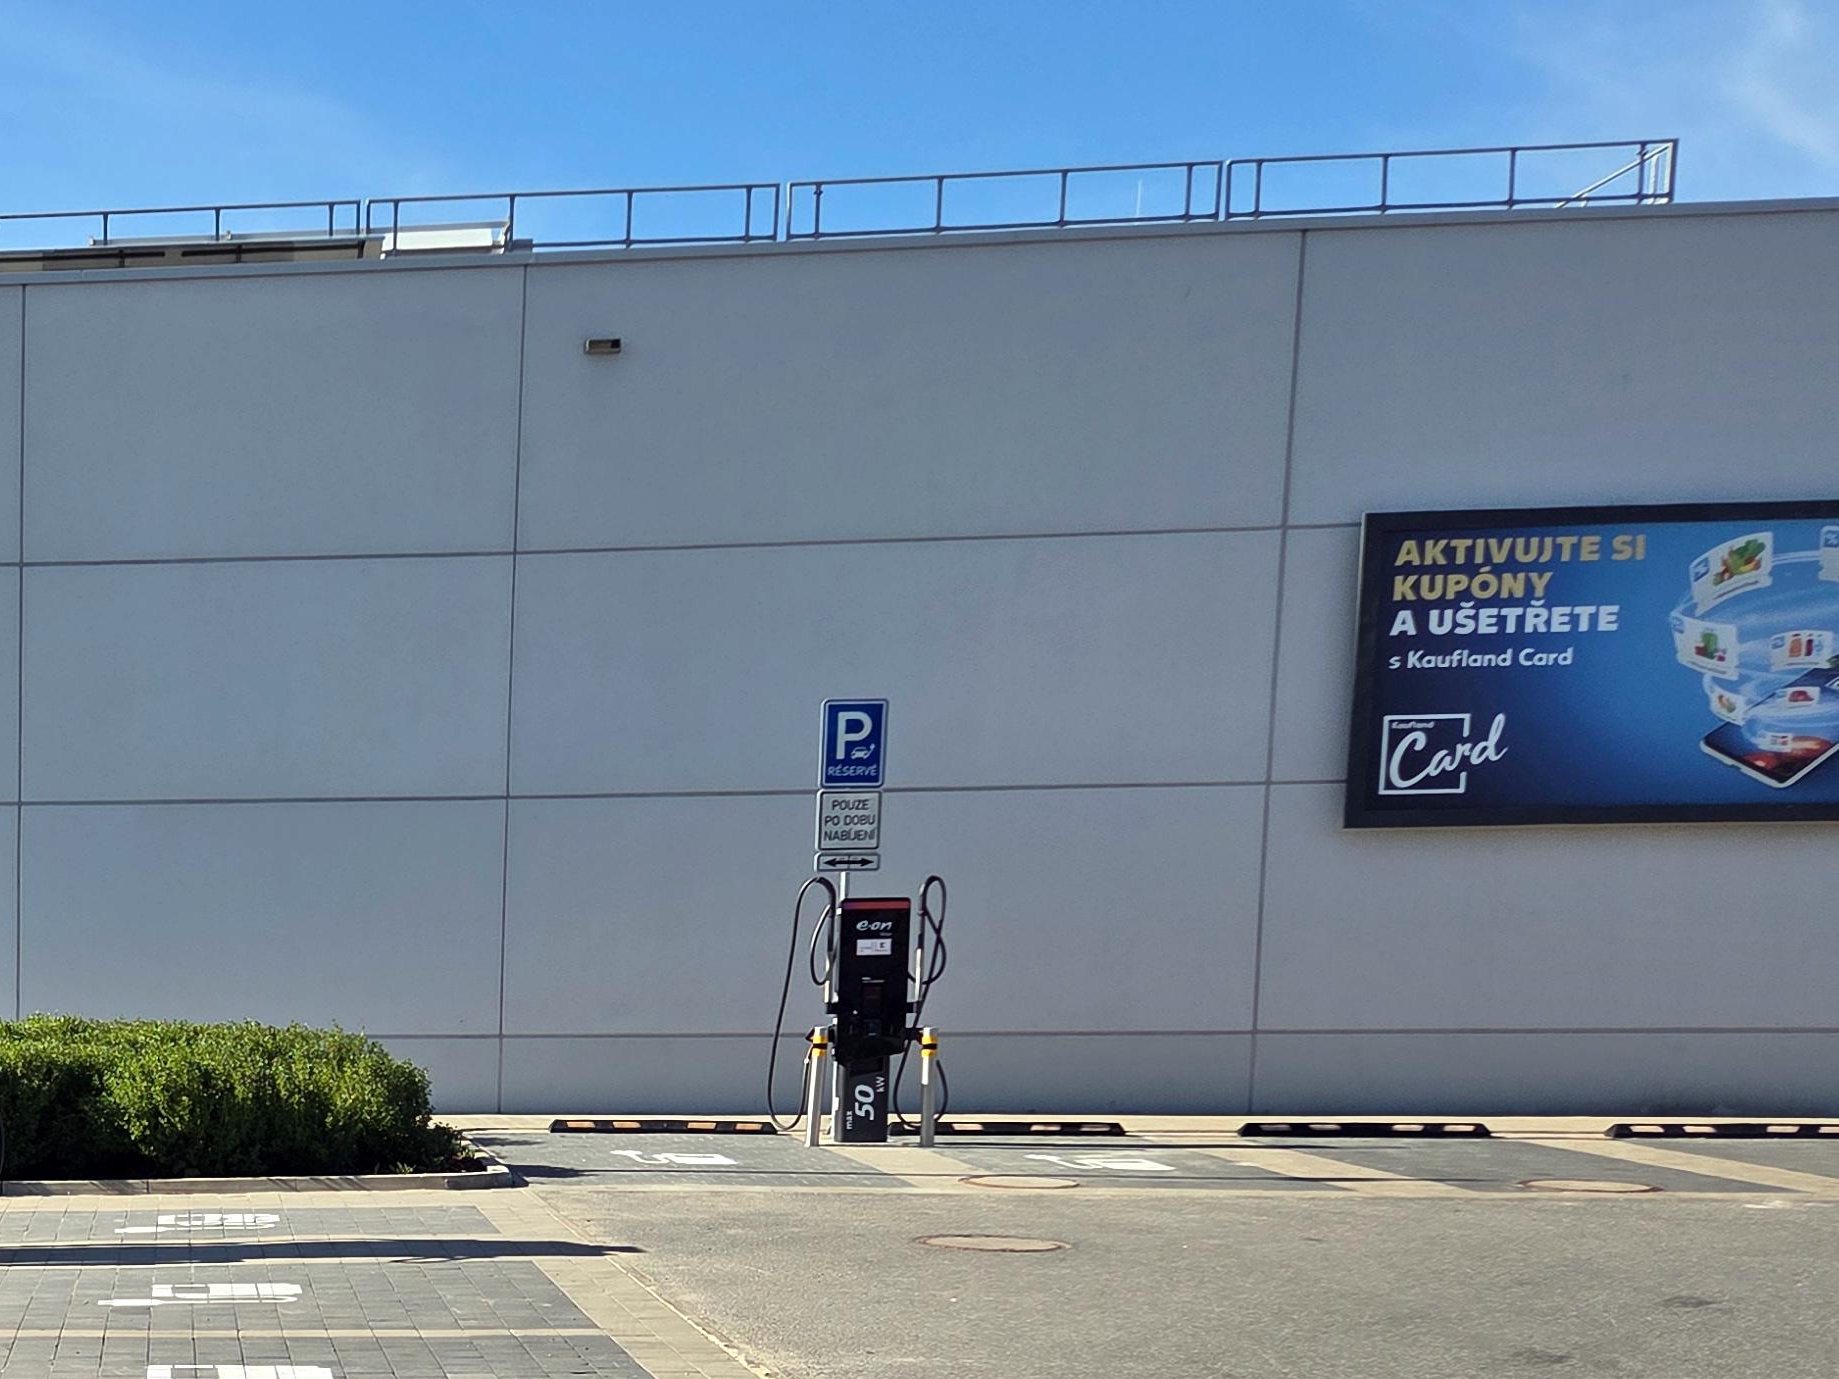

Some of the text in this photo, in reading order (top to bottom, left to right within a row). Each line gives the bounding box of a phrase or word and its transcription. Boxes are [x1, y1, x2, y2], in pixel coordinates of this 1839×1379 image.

[1394, 535, 1647, 566] AKTIVUJTE SI
[1392, 566, 1554, 601] KUPÓNY
[1389, 600, 1621, 636] A UŠETŘETE
[1388, 647, 1574, 669] s Kaufland Card
[836, 711, 873, 760] P
[1389, 712, 1508, 788] Card
[824, 814, 876, 826] PO DOBU
[832, 799, 870, 811] POUZE
[823, 828, 876, 841] NABÍJENÍ
[854, 1084, 875, 1121] 50
